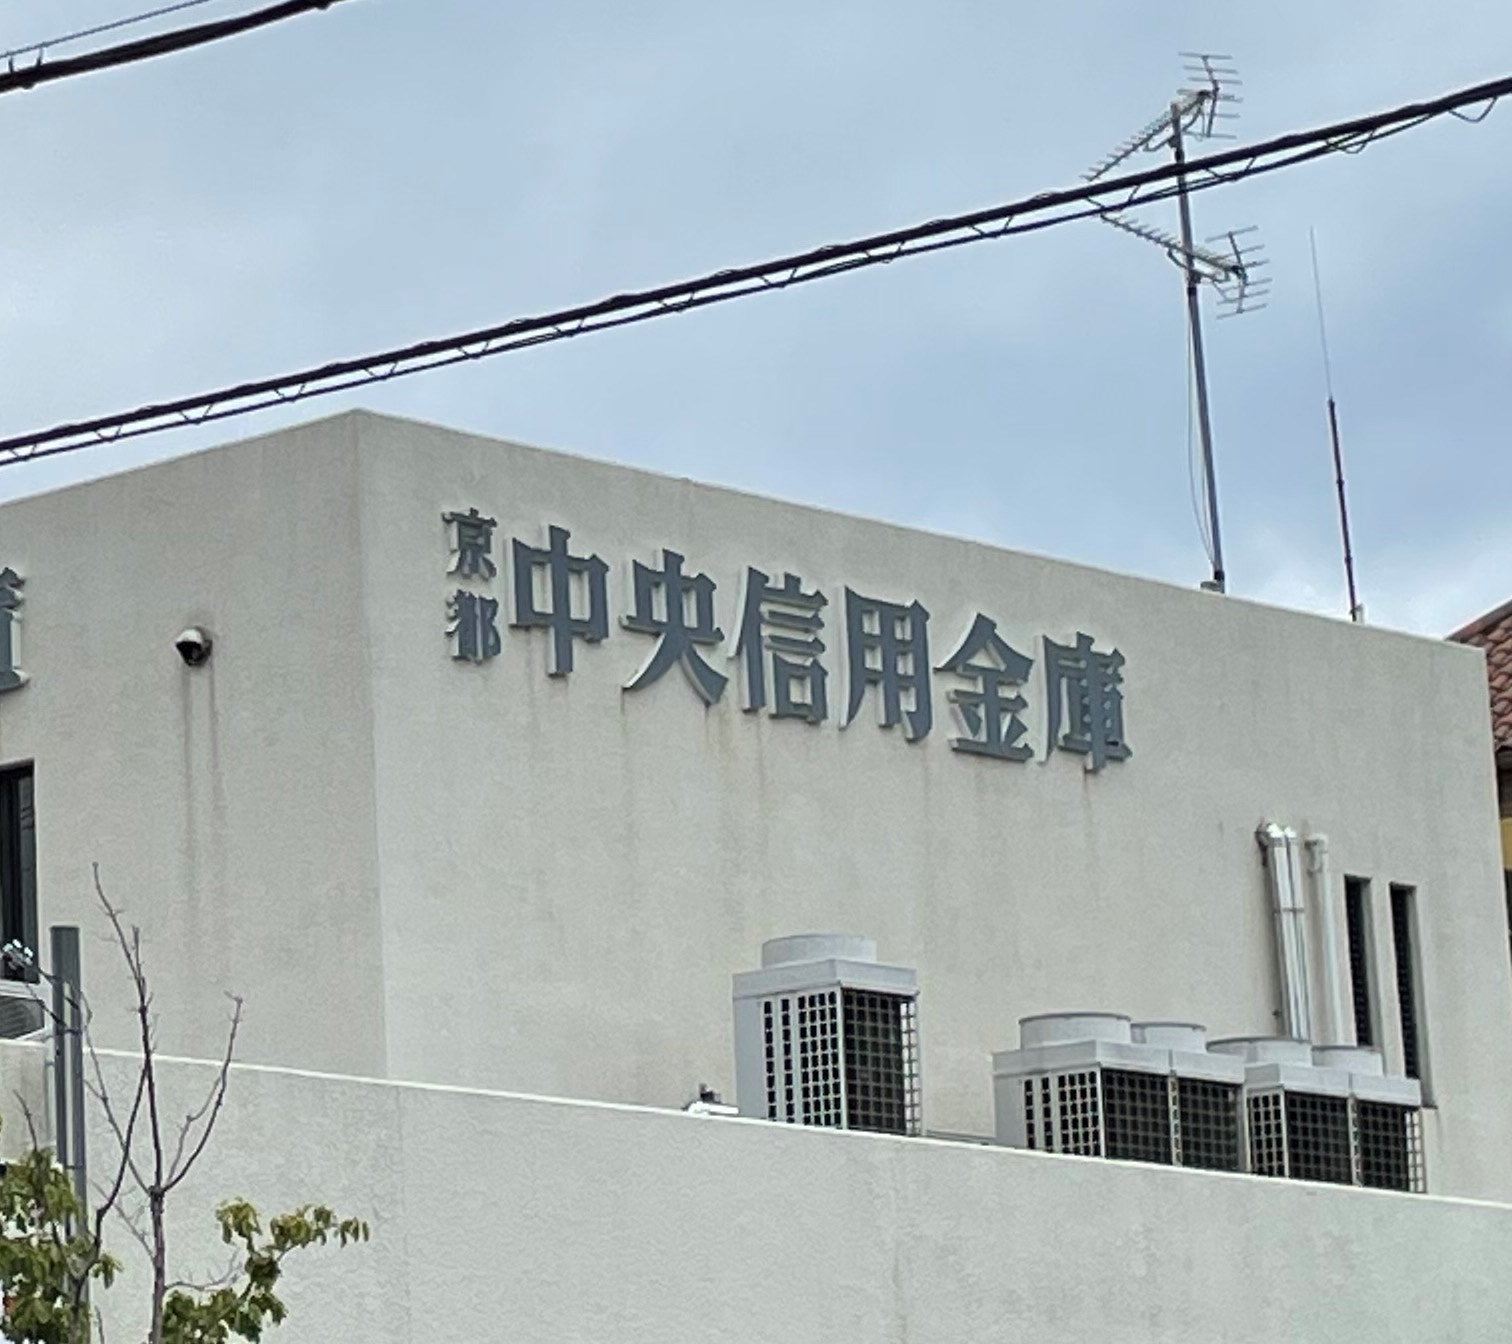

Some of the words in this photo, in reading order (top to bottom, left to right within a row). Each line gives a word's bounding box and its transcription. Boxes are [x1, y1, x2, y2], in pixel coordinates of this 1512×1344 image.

[441, 507, 499, 663] 京都
[509, 523, 1133, 774] 中央信用金庫
